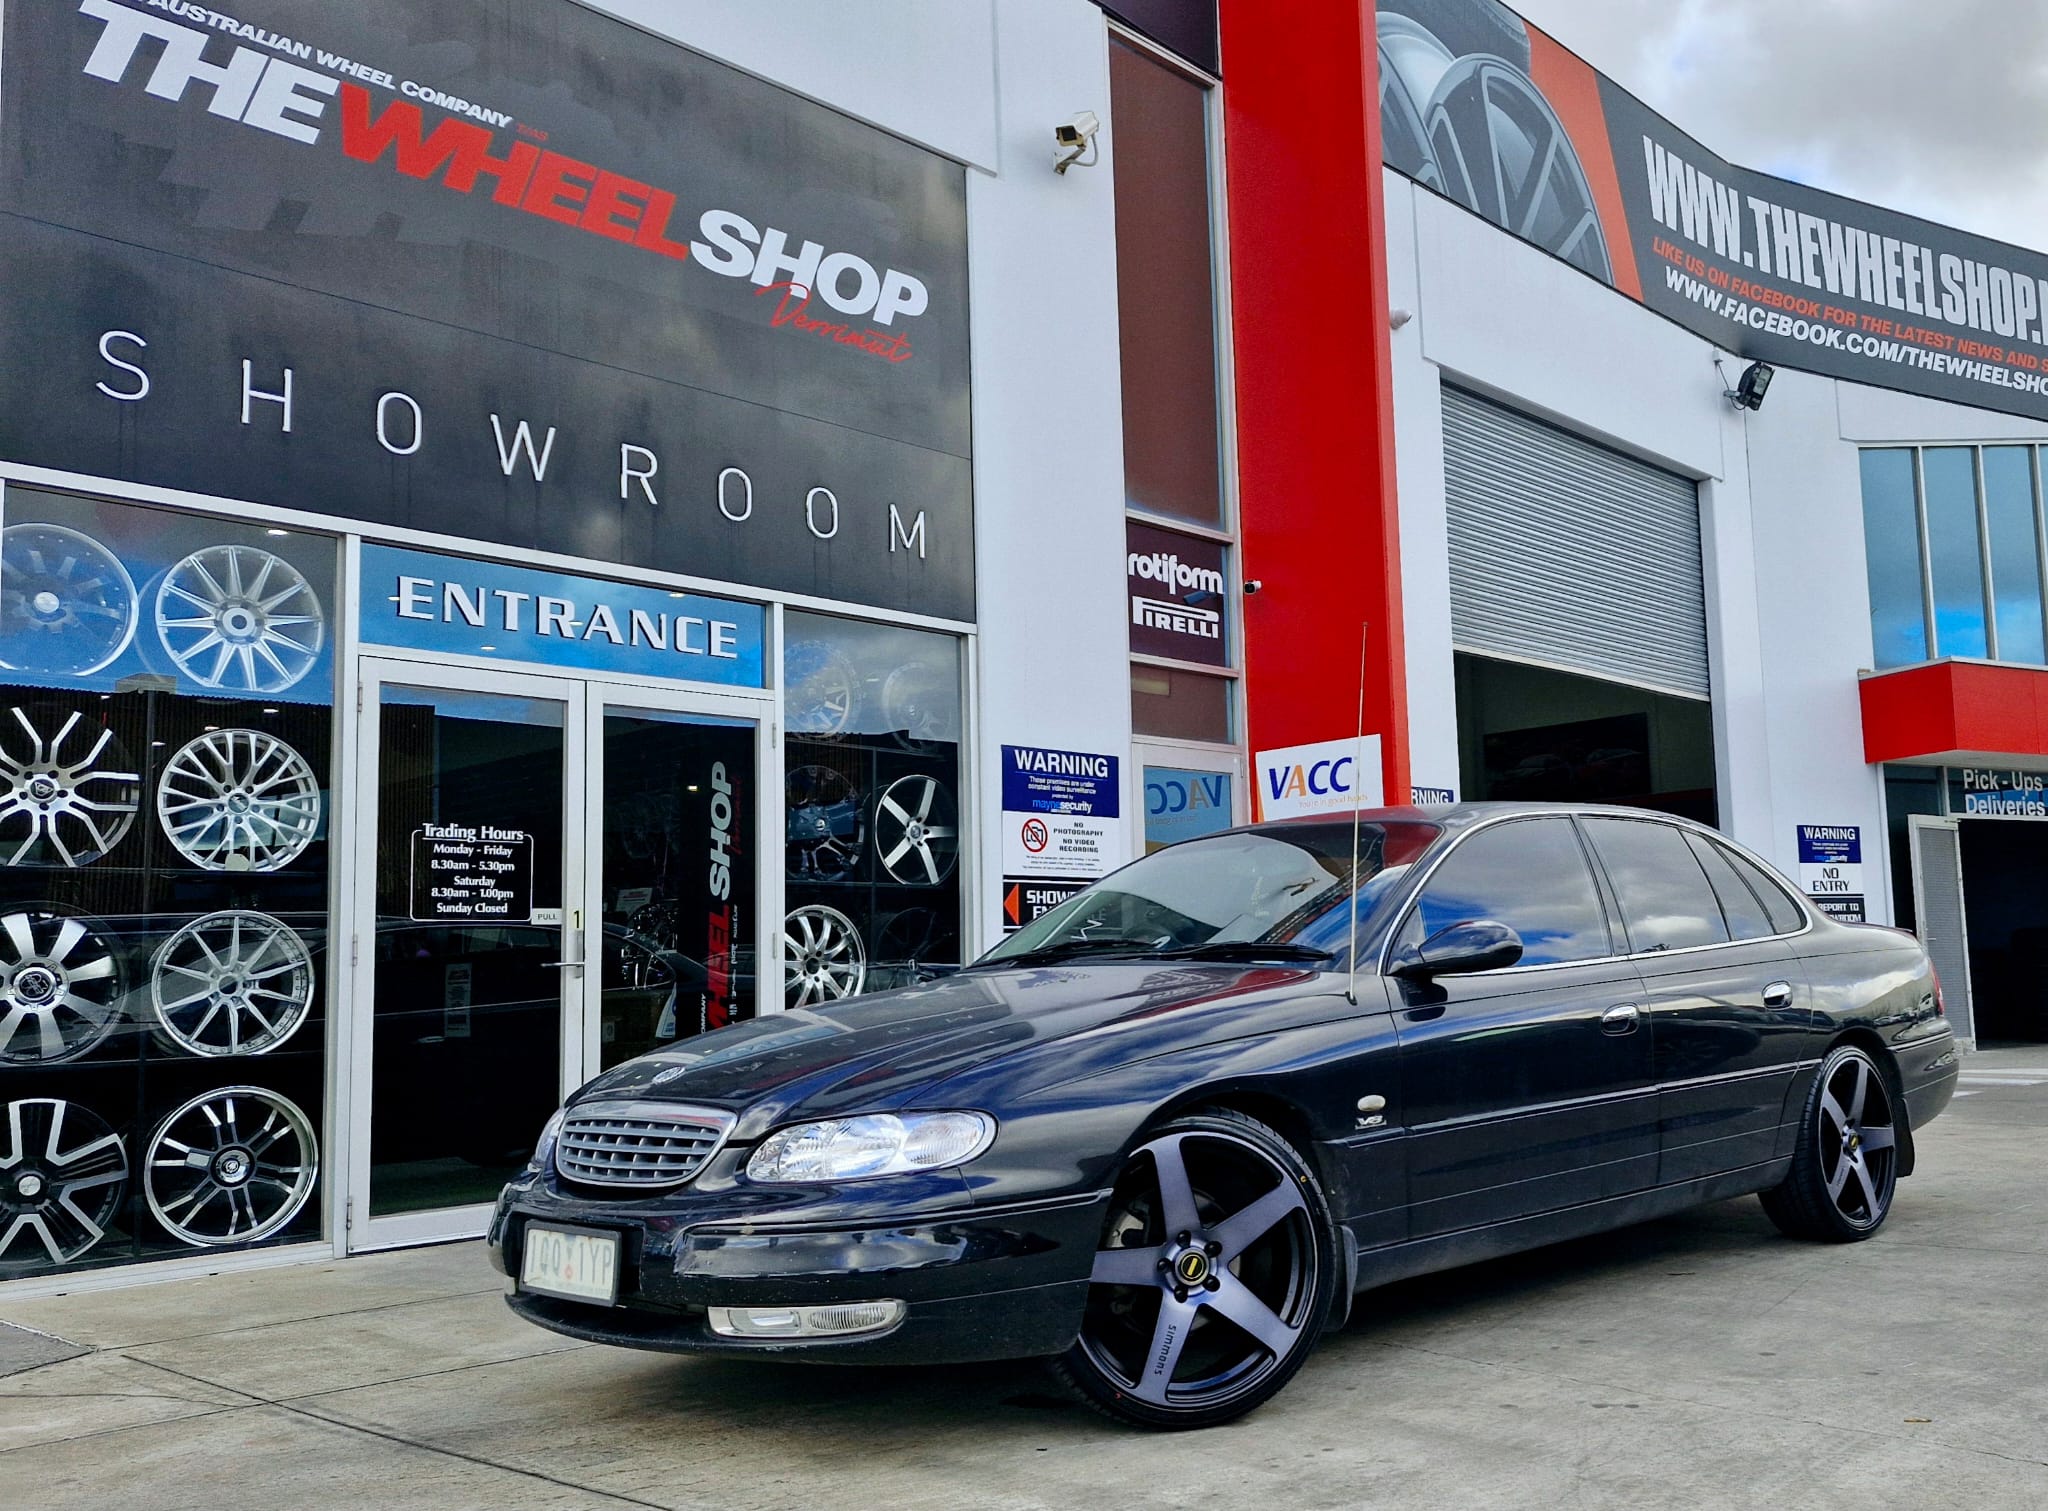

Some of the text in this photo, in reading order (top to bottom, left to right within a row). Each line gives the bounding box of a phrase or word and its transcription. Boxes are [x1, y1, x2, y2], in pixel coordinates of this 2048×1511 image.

[147, 0, 514, 129] AUSTRALIAN WHEEL COMPANY
[78, 0, 929, 326] THE WHEEL SHOP
[1653, 236, 1683, 266] LIKE
[1685, 256, 1705, 277] US
[1708, 266, 1729, 289] ON
[1730, 276, 1821, 318] FACEBOOK
[1822, 305, 1857, 328] FOR
[1861, 314, 1893, 336] THE
[1894, 323, 1955, 350] LATEST
[1957, 338, 2004, 362] NEWS
[2006, 351, 2038, 370] AND
[96, 330, 926, 559] SHOWROOM
[1128, 552, 1224, 595] rotiform
[397, 575, 738, 659] ENTRANCE
[1132, 595, 1219, 639] PIRELLI
[1014, 749, 1108, 778] WARNING
[1268, 757, 1353, 800] VACC
[1963, 768, 1999, 790] Pick
[2011, 771, 2043, 796] Ups
[1411, 788, 1449, 805] RNING
[1964, 794, 2046, 816] Deliveries
[422, 823, 524, 843] Trading Hours
[710, 761, 731, 901] SHOP
[1053, 828, 1104, 836] PHOTOGRAPHY
[1803, 826, 1856, 840] WARNING
[433, 843, 474, 857] Monday
[484, 845, 513, 858] Friday
[1059, 845, 1099, 853] RECORDING
[431, 859, 469, 870] 8.30am
[479, 861, 515, 873] 5.30pm
[1822, 867, 1839, 879] NO
[453, 875, 496, 888] Saturday
[1812, 880, 1850, 892] ENTRY
[431, 887, 469, 898] 8.30am
[436, 902, 508, 915] Sunday Closed
[1849, 903, 1859, 911] TO
